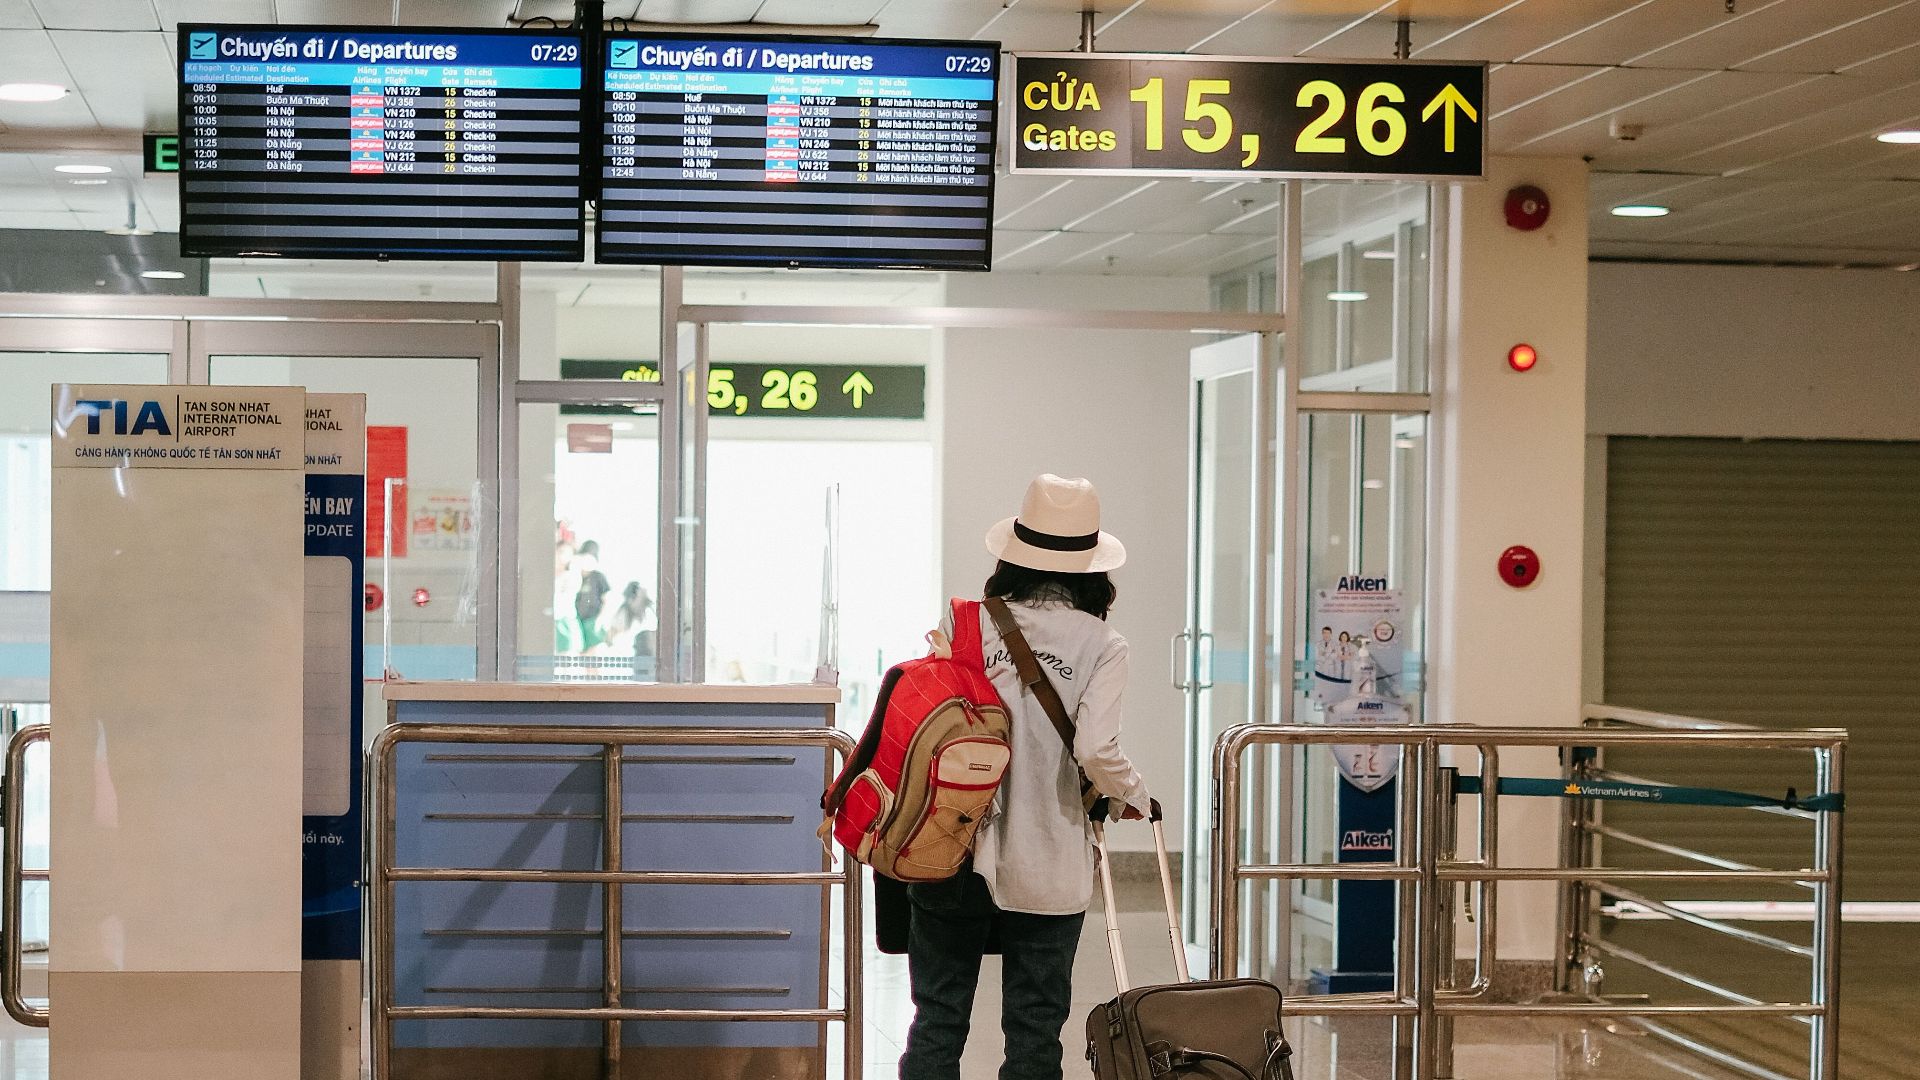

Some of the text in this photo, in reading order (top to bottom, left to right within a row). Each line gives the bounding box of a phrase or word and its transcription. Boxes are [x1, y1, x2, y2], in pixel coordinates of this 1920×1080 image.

[221, 36, 578, 63] Chuyến đi / Departures 07:29
[641, 45, 991, 73] Chuyến đi / Departures 07:29
[266, 75, 310, 83] Destination
[193, 84, 217, 93] 08:50
[266, 84, 284, 93] Huế
[385, 87, 398, 95] VN
[400, 87, 421, 95] 1372
[444, 88, 456, 96] 15
[463, 88, 497, 97] Check-in
[1023, 72, 1101, 112] CỬA
[193, 95, 217, 104] 09:10
[266, 95, 288, 104] Buôn
[289, 96, 303, 104] Ma
[304, 96, 329, 106] Thuột
[385, 98, 396, 106] VJ
[398, 98, 414, 106] 358
[444, 99, 456, 107] 26
[463, 99, 497, 108] Check-in
[612, 92, 636, 101] 08:50
[684, 93, 703, 102] Huế
[801, 96, 815, 105] VN
[816, 96, 837, 105] 1372
[860, 97, 871, 106] 15
[193, 106, 217, 115] 10:00
[266, 106, 279, 115] Hà
[280, 106, 295, 116] Nội
[385, 109, 398, 117] VN
[399, 109, 416, 117] 210
[444, 110, 456, 118] 15
[463, 110, 497, 119] Check-in
[612, 103, 636, 112] 09:10
[801, 107, 812, 116] VJ
[813, 107, 829, 116] 358
[859, 108, 870, 117] 26
[193, 117, 217, 126] 10:05
[266, 117, 279, 126] Hà
[280, 117, 295, 127] Nội
[385, 120, 396, 128] VJ
[399, 120, 414, 128] 126
[444, 121, 456, 129] 26
[463, 121, 497, 130] Check-in
[612, 114, 636, 123] 10:00
[800, 118, 814, 127] VN
[814, 118, 831, 127] 210
[859, 119, 870, 128] 15
[1130, 77, 1408, 168] 15, 26
[193, 128, 217, 137] 11:00
[266, 128, 279, 137] Hà
[280, 128, 295, 138] Nội
[385, 131, 398, 139] VN
[399, 131, 416, 139] 246
[444, 132, 456, 140] 15
[463, 132, 497, 141] Check-in
[612, 125, 870, 139] 10:05 26
[1023, 123, 1117, 152] Gates
[193, 139, 217, 148] 11:25
[266, 139, 278, 148] Đà
[385, 142, 396, 150] VJ
[398, 142, 414, 150] 622
[444, 143, 456, 151] 26
[463, 143, 497, 152] Check-in
[612, 136, 635, 145] 11:00
[800, 139, 813, 148] VN
[814, 139, 830, 149] 246
[858, 141, 869, 149] 15
[193, 150, 217, 159] 12:00
[266, 150, 279, 159] Hà
[280, 150, 295, 160] Nội
[385, 153, 398, 161] VN
[399, 153, 416, 161] 212
[444, 154, 456, 162] 15
[463, 154, 497, 163] Check-in
[611, 147, 869, 160] 11:25 26
[193, 161, 217, 170] 12:45
[266, 161, 278, 170] Đà
[385, 164, 396, 172] VJ
[398, 164, 414, 172] 644
[444, 165, 456, 173] 26
[463, 165, 497, 174] Check-in
[611, 157, 869, 171] 12:00 15
[611, 168, 634, 177] 12:45
[761, 369, 818, 410] 26
[185, 401, 270, 413] TAN SON NHAT
[75, 400, 172, 436] TIA
[183, 413, 282, 425] INTERNATIONAL
[185, 426, 236, 437] AIRPORT
[75, 447, 102, 458] CẢNG
[104, 447, 131, 458] HÀNG
[133, 447, 167, 458] KHÔNG
[169, 446, 196, 459] QUỐC
[199, 446, 211, 459] TẾ
[213, 448, 232, 459] TÂN
[256, 446, 282, 460] NHẤT
[325, 497, 353, 516] BAY
[305, 524, 354, 536] PDATE
[1337, 576, 1387, 592] Aiken
[1357, 701, 1384, 710] Aiken
[1581, 786, 1650, 798] Vietnam Airlines
[1343, 830, 1392, 849] Aiken
